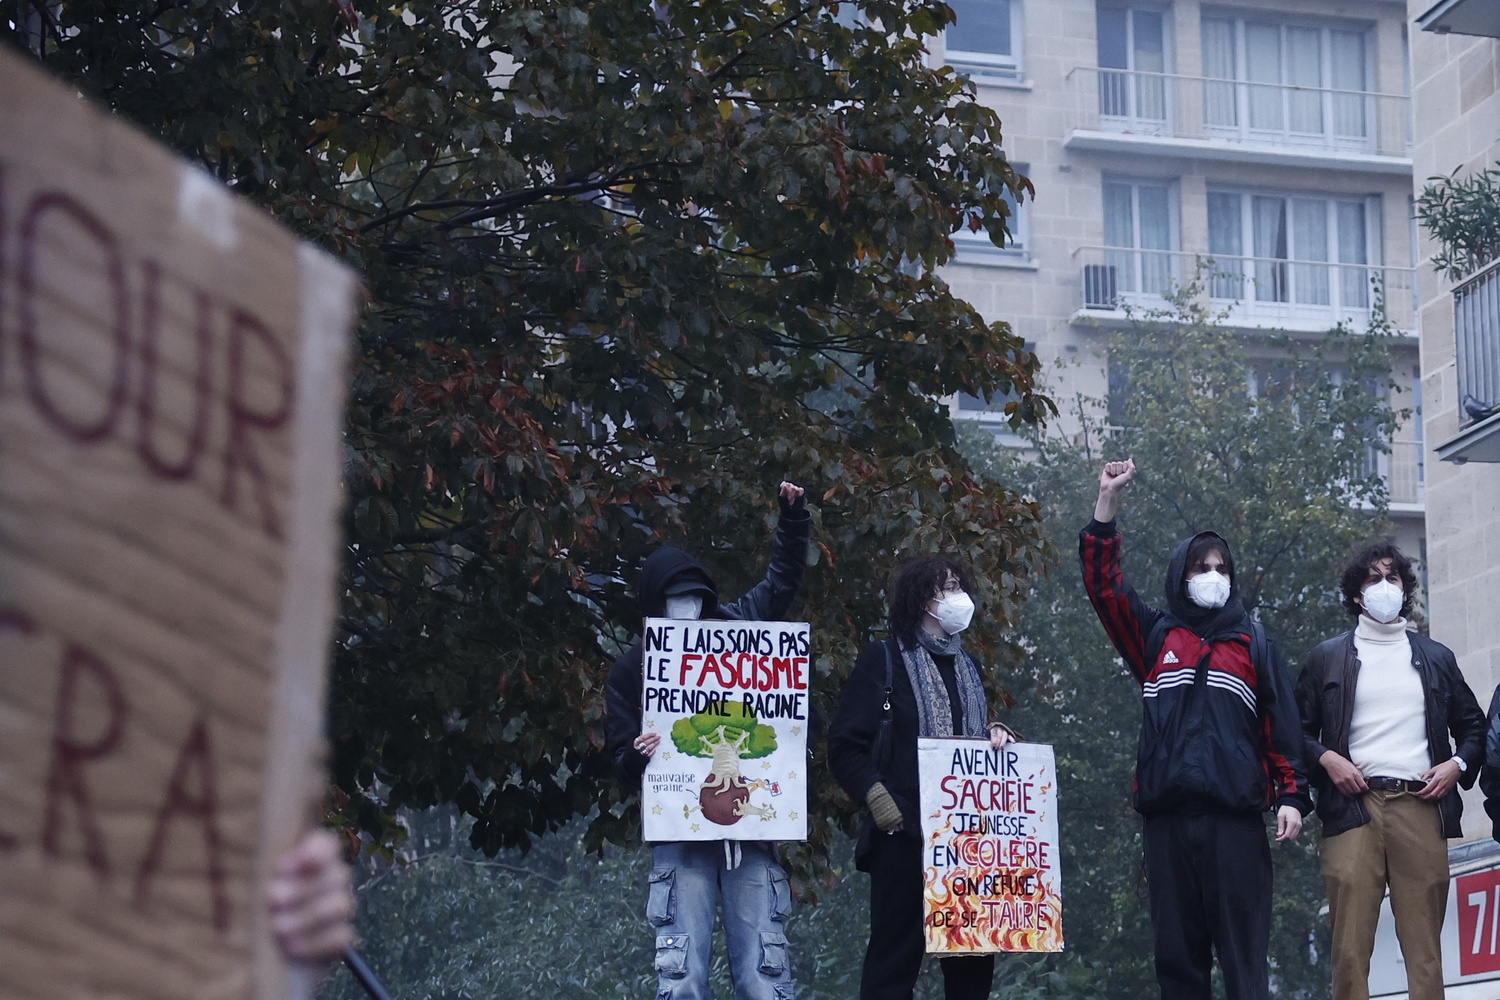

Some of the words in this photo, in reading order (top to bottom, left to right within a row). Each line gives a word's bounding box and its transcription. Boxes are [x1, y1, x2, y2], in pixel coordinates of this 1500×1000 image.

[0, 160, 295, 543] OUR
[645, 626, 675, 652] NE
[683, 627, 773, 657] LAISSONS
[779, 631, 810, 657] PAS
[646, 656, 671, 683] LE
[679, 652, 808, 691] FASCISME
[645, 687, 734, 718] PRENDRE
[742, 691, 806, 720] RACINE
[951, 748, 1020, 777] AVENIR
[648, 773, 696, 783] mauvaise
[652, 783, 683, 793] graine
[953, 812, 1028, 836] JEUNESSE
[933, 845, 959, 867] EN
[962, 836, 1051, 869] COLÈRE
[952, 876, 979, 896] ON
[983, 874, 1035, 896] REFUSE
[933, 910, 955, 928] DE
[961, 911, 978, 928] SE
